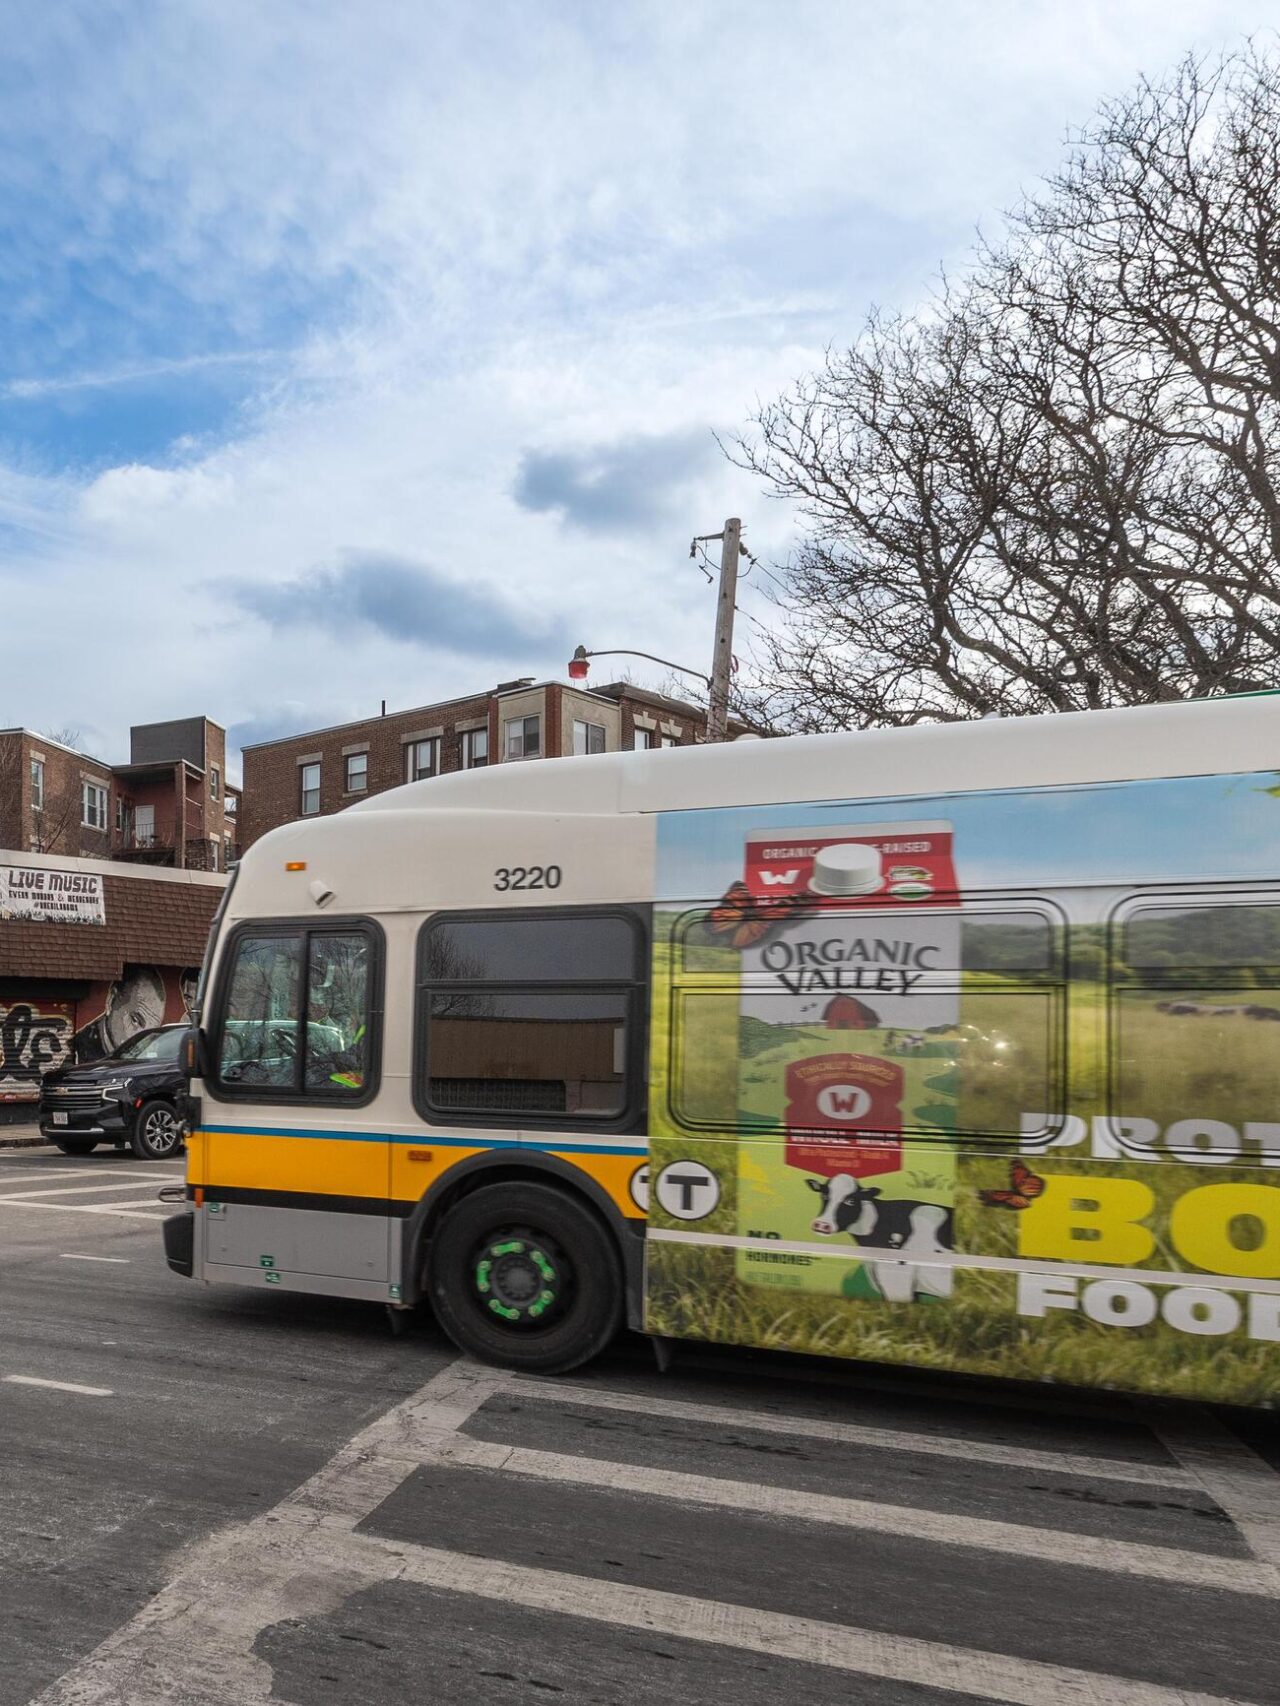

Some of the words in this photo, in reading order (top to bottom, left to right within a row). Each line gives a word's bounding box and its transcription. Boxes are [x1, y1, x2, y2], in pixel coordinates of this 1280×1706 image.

[8, 870, 45, 889] LIVE
[48, 873, 98, 894] MUSIC
[494, 865, 562, 891] 3220
[761, 938, 940, 971] ORGANIC
[776, 966, 924, 996] VALLEY
[828, 1092, 859, 1113] W
